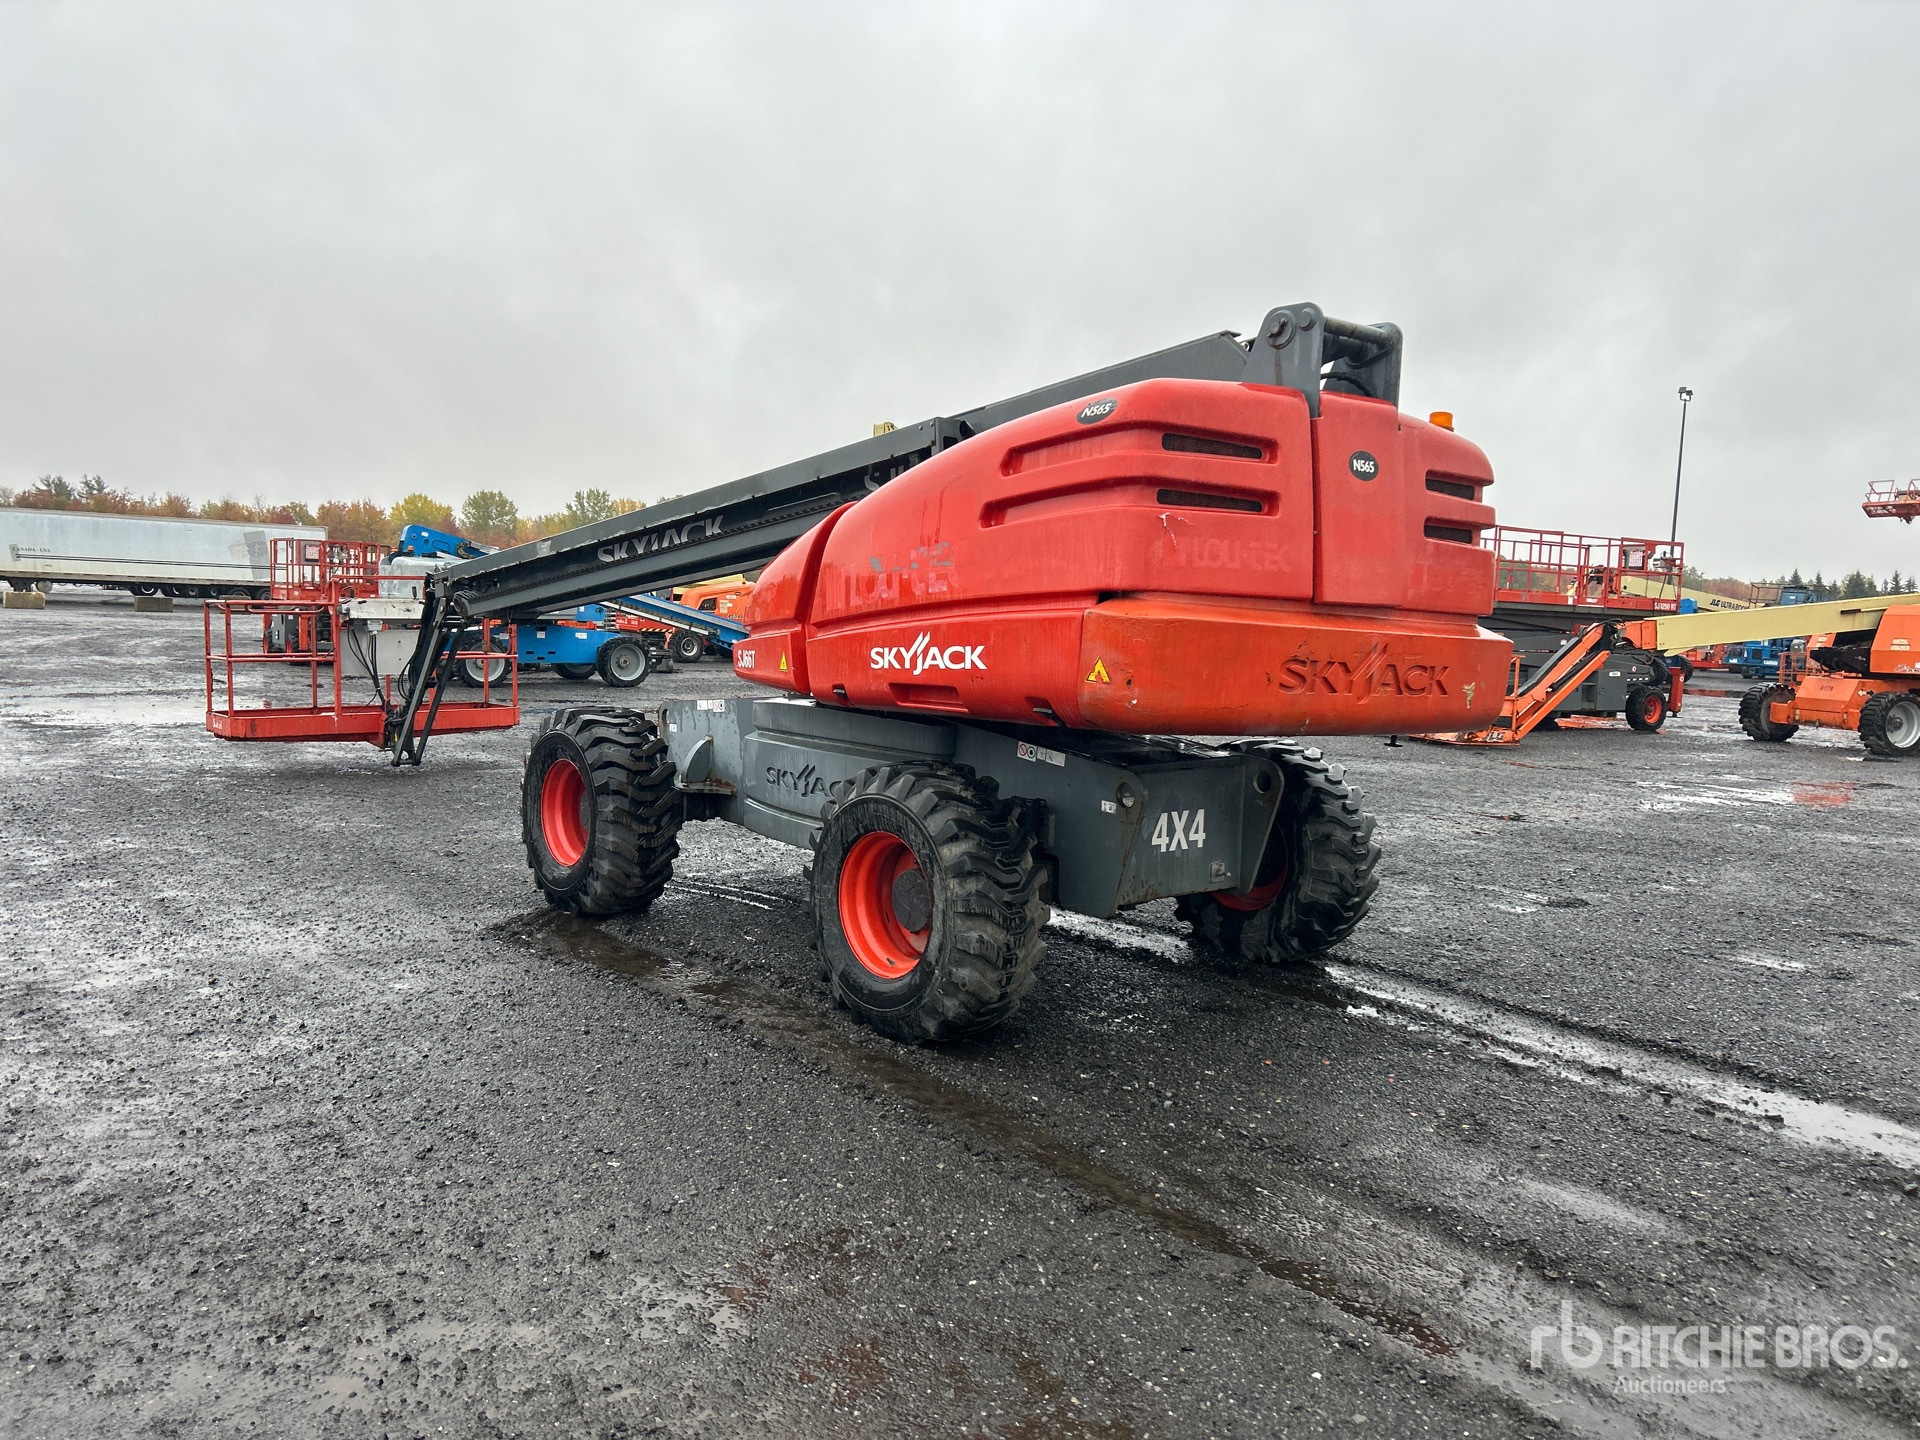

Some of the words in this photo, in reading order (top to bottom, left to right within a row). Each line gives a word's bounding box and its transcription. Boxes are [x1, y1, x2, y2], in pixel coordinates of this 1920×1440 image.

[1081, 402, 1113, 418] N565
[1352, 458, 1375, 474] N565
[596, 514, 724, 563] SKYJACK
[737, 649, 756, 669] SJ66T
[870, 630, 988, 676] SKYJACK
[1278, 643, 1451, 705] SKYJACK
[765, 763, 843, 798] SKYJAC
[1151, 808, 1207, 853] 4X4
